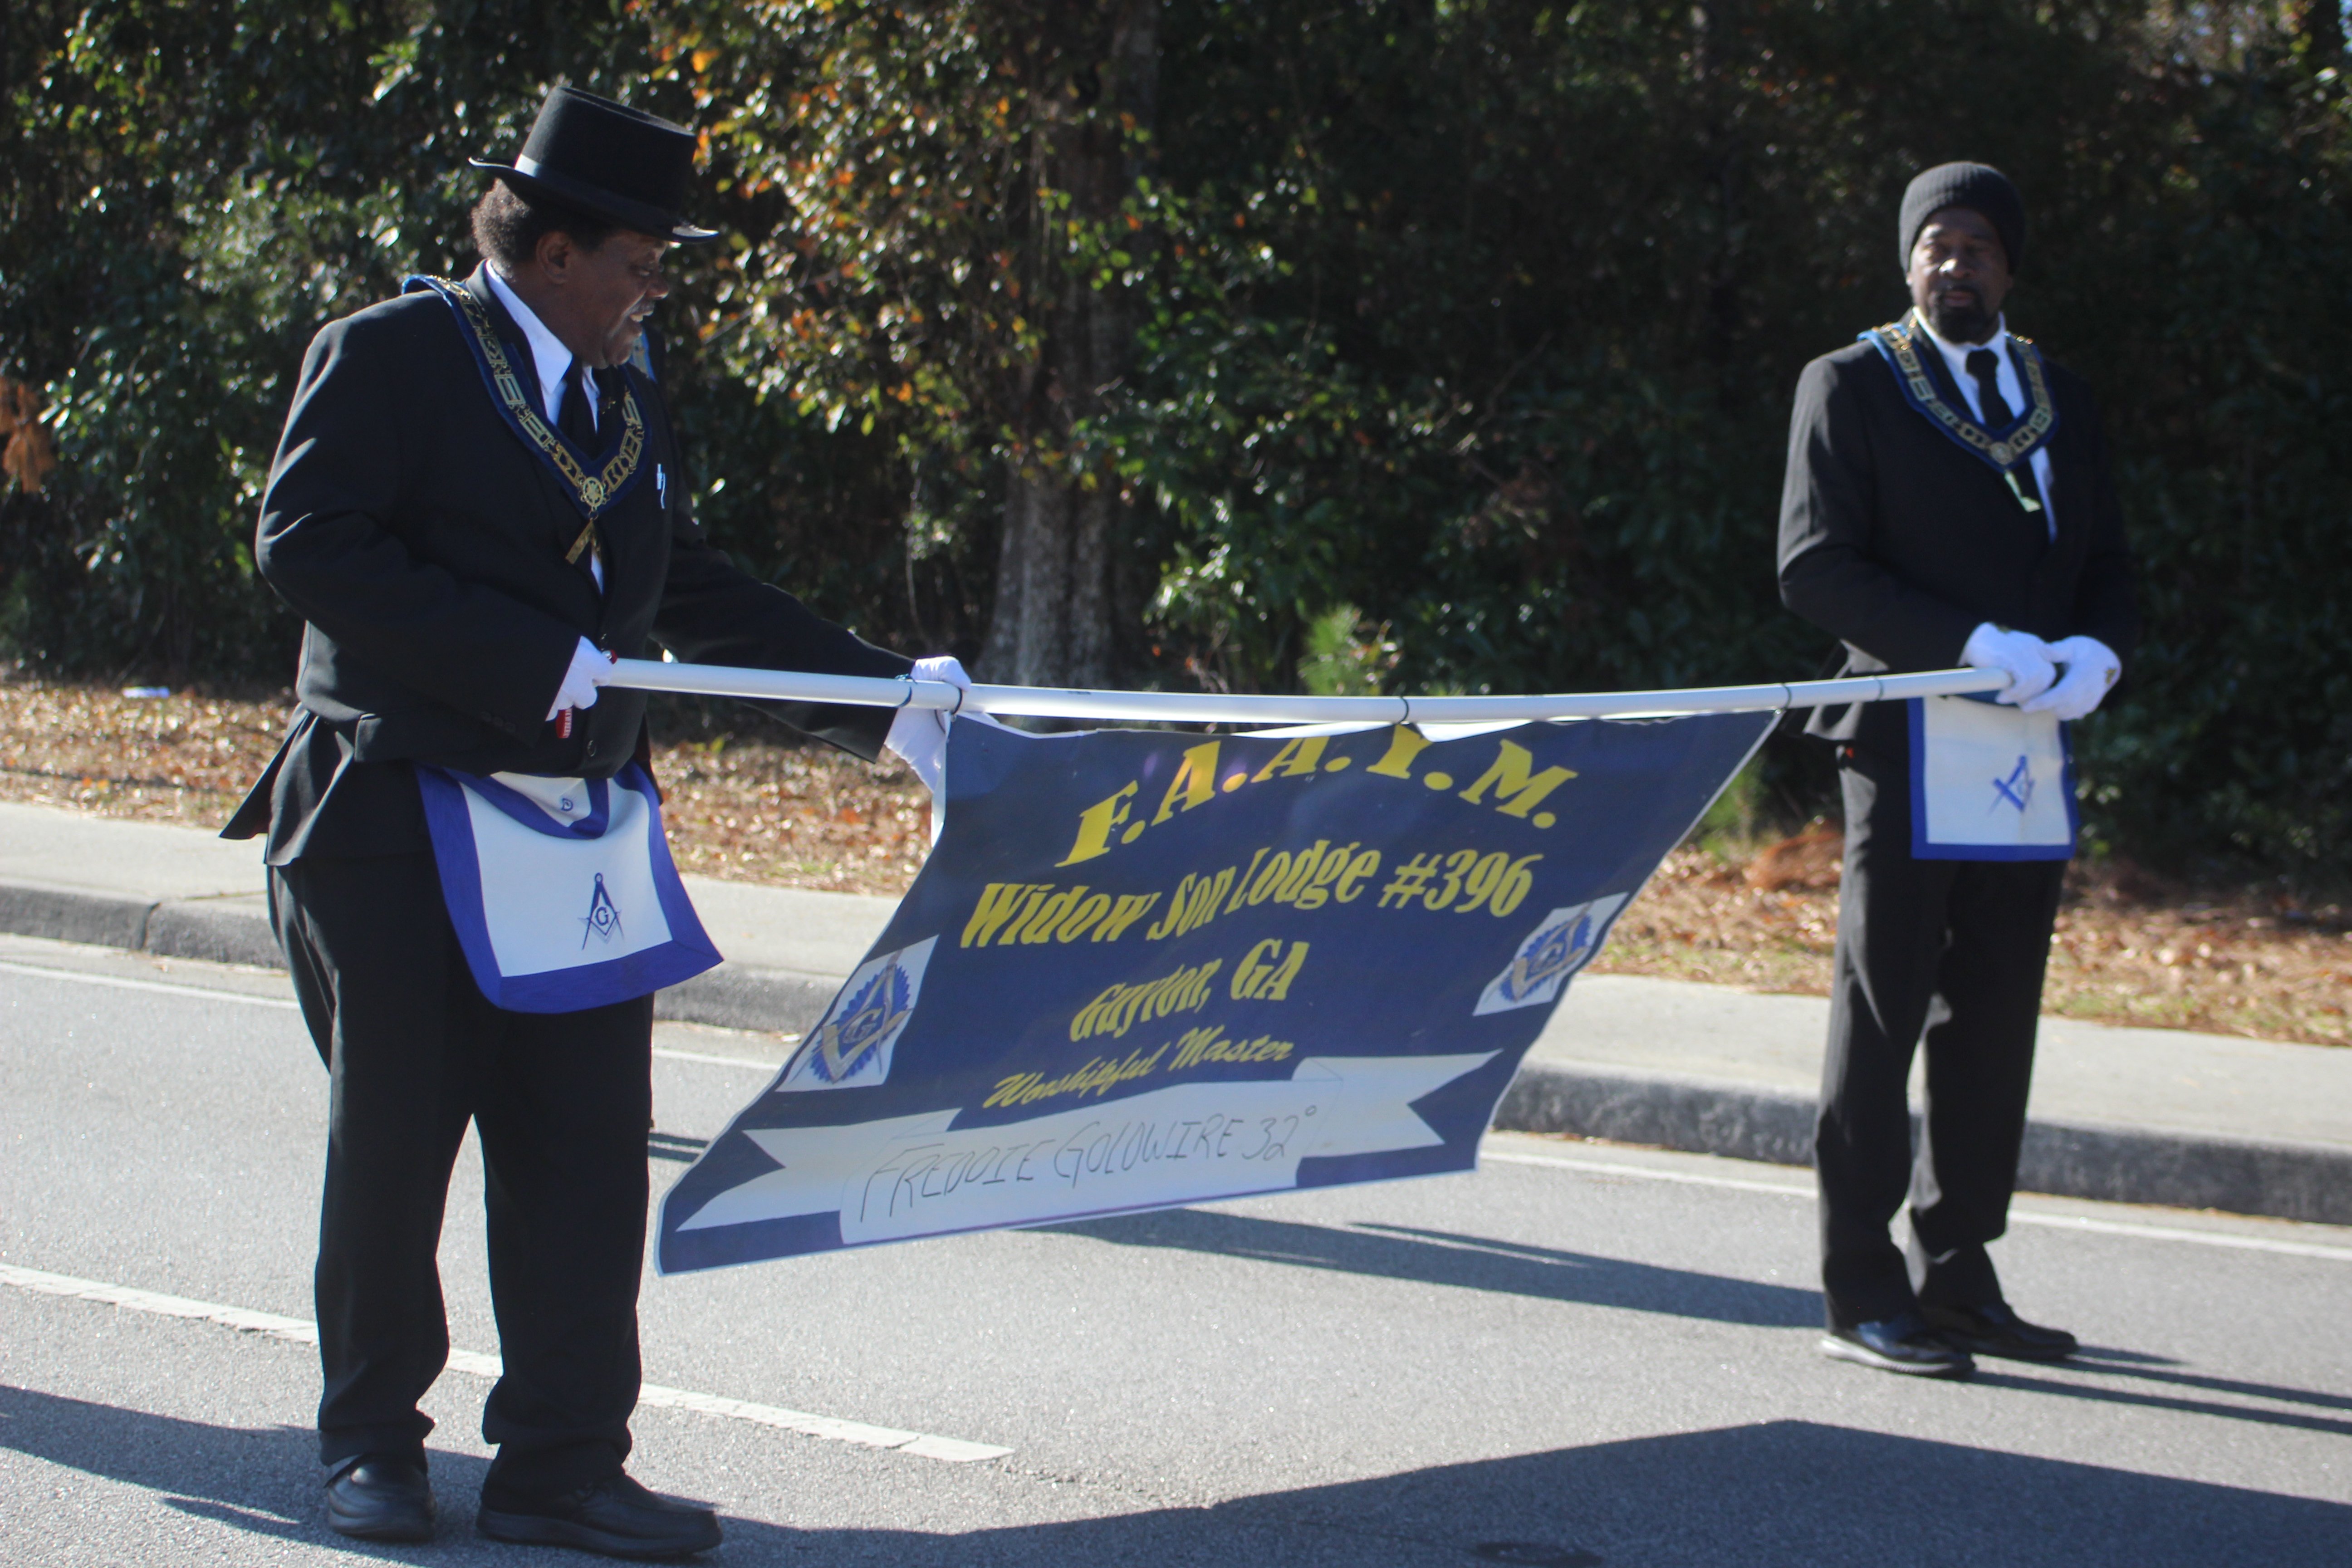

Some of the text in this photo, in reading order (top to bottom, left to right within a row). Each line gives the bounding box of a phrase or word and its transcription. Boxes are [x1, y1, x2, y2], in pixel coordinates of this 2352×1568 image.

[595, 906, 609, 926] G
[960, 839, 1544, 948] Widow Son Lodge #396
[1069, 938, 1310, 1042] Guyton, GA
[982, 1024, 1294, 1108] Worshipful Master
